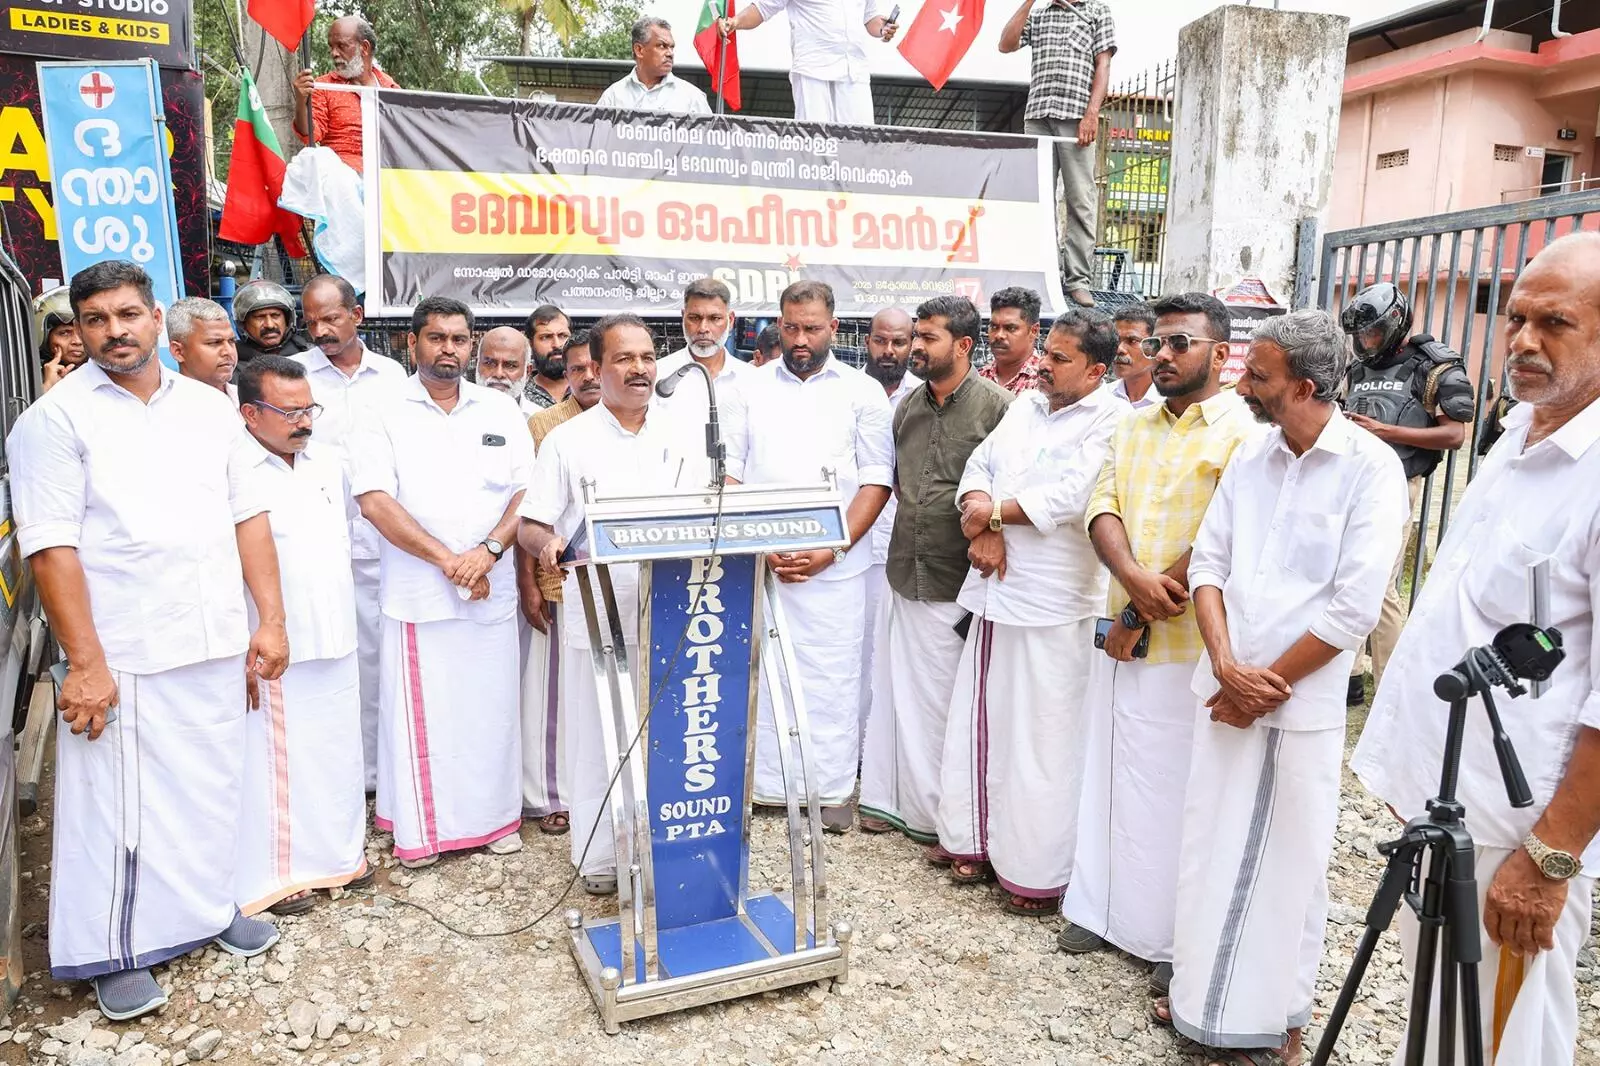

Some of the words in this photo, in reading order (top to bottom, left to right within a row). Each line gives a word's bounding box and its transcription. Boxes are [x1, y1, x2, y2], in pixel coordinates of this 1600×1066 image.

[22, 13, 92, 32] LADIES
[98, 22, 110, 34] &
[117, 24, 160, 39] KIDS
[615, 123, 703, 145] ശബരിമല
[535, 145, 608, 166] ഭക്തരെ
[682, 155, 748, 179] ദേവസ്വം
[451, 191, 646, 245] ദേവസ്വം
[656, 193, 847, 248] ഓഫീസ്
[1353, 380, 1405, 392] POLICE
[613, 522, 739, 545] BROTHERS
[682, 556, 726, 793] BROTHERS
[659, 795, 732, 822] SOUND
[666, 819, 727, 842] PTA
